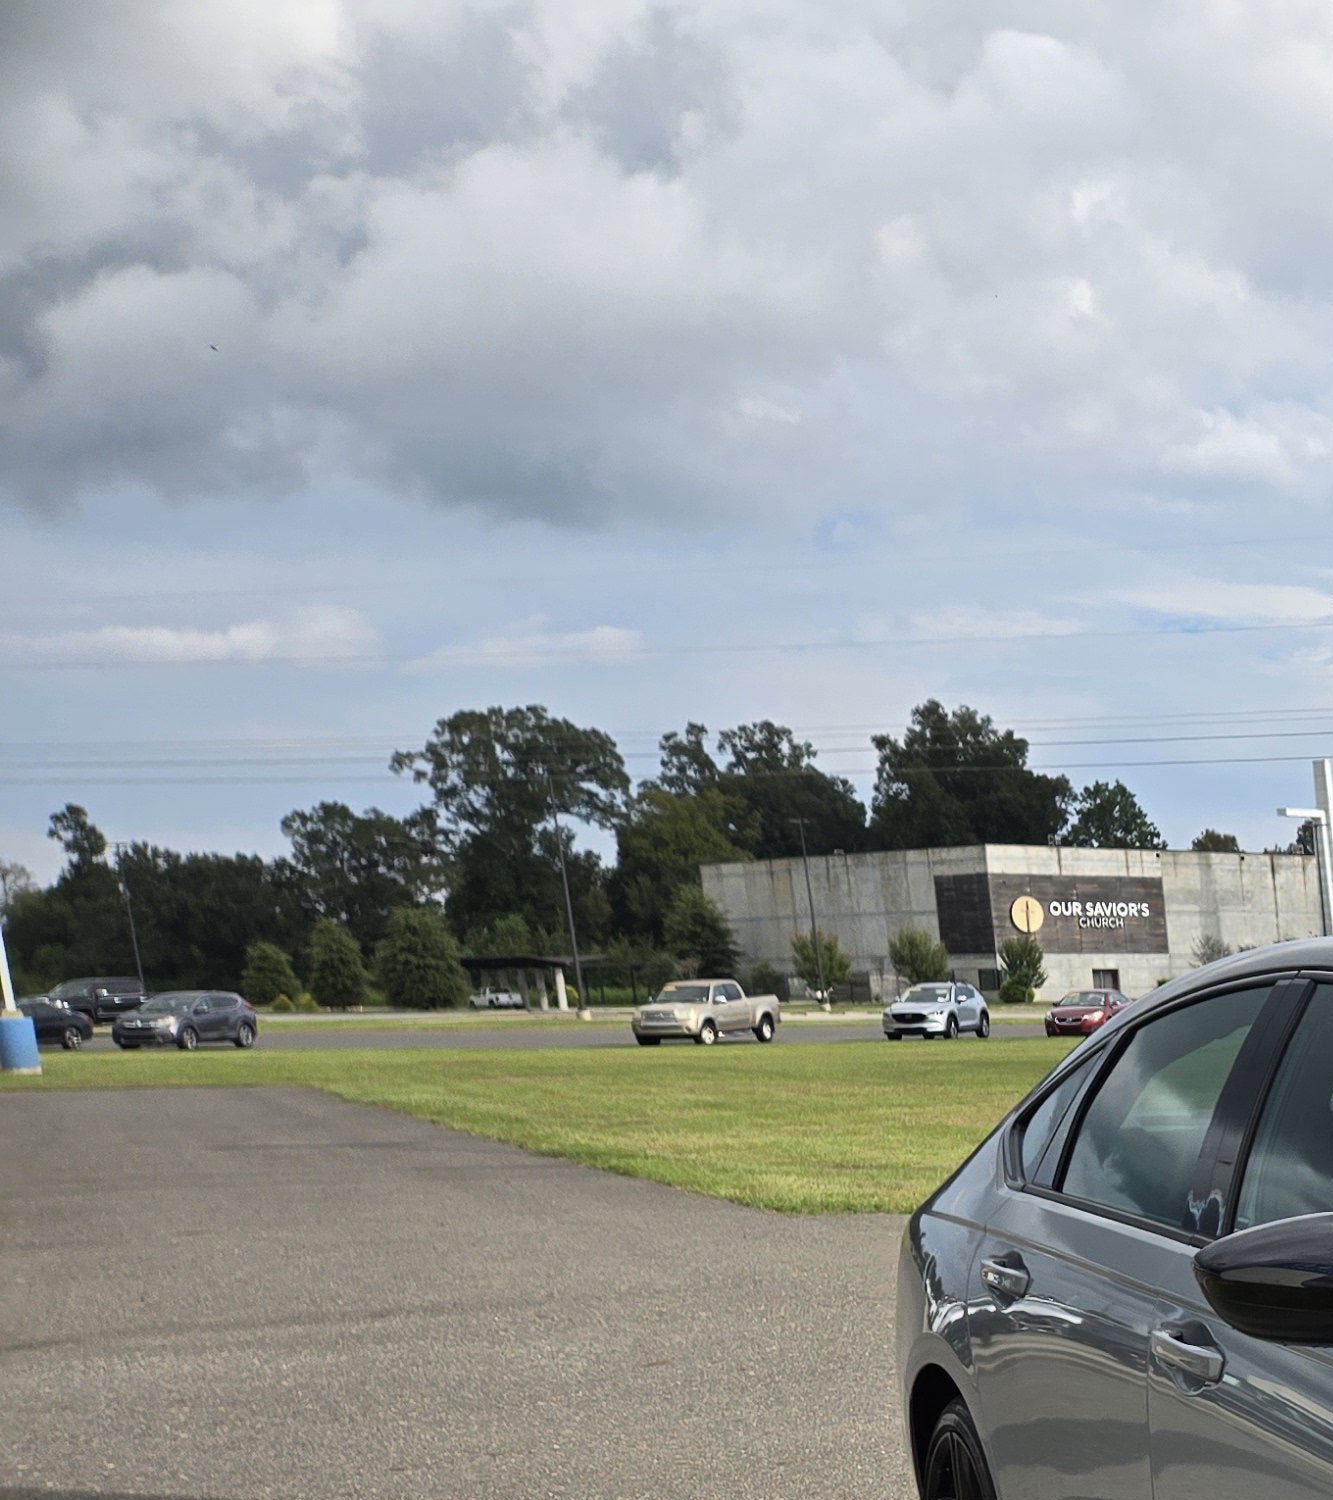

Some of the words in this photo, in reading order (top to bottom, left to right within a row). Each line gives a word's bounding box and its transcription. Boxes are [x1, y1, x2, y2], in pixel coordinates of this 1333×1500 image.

[1049, 901, 1082, 917] OUR
[1085, 901, 1150, 918] SAVIOR'S
[1079, 917, 1124, 929] CHURCH
